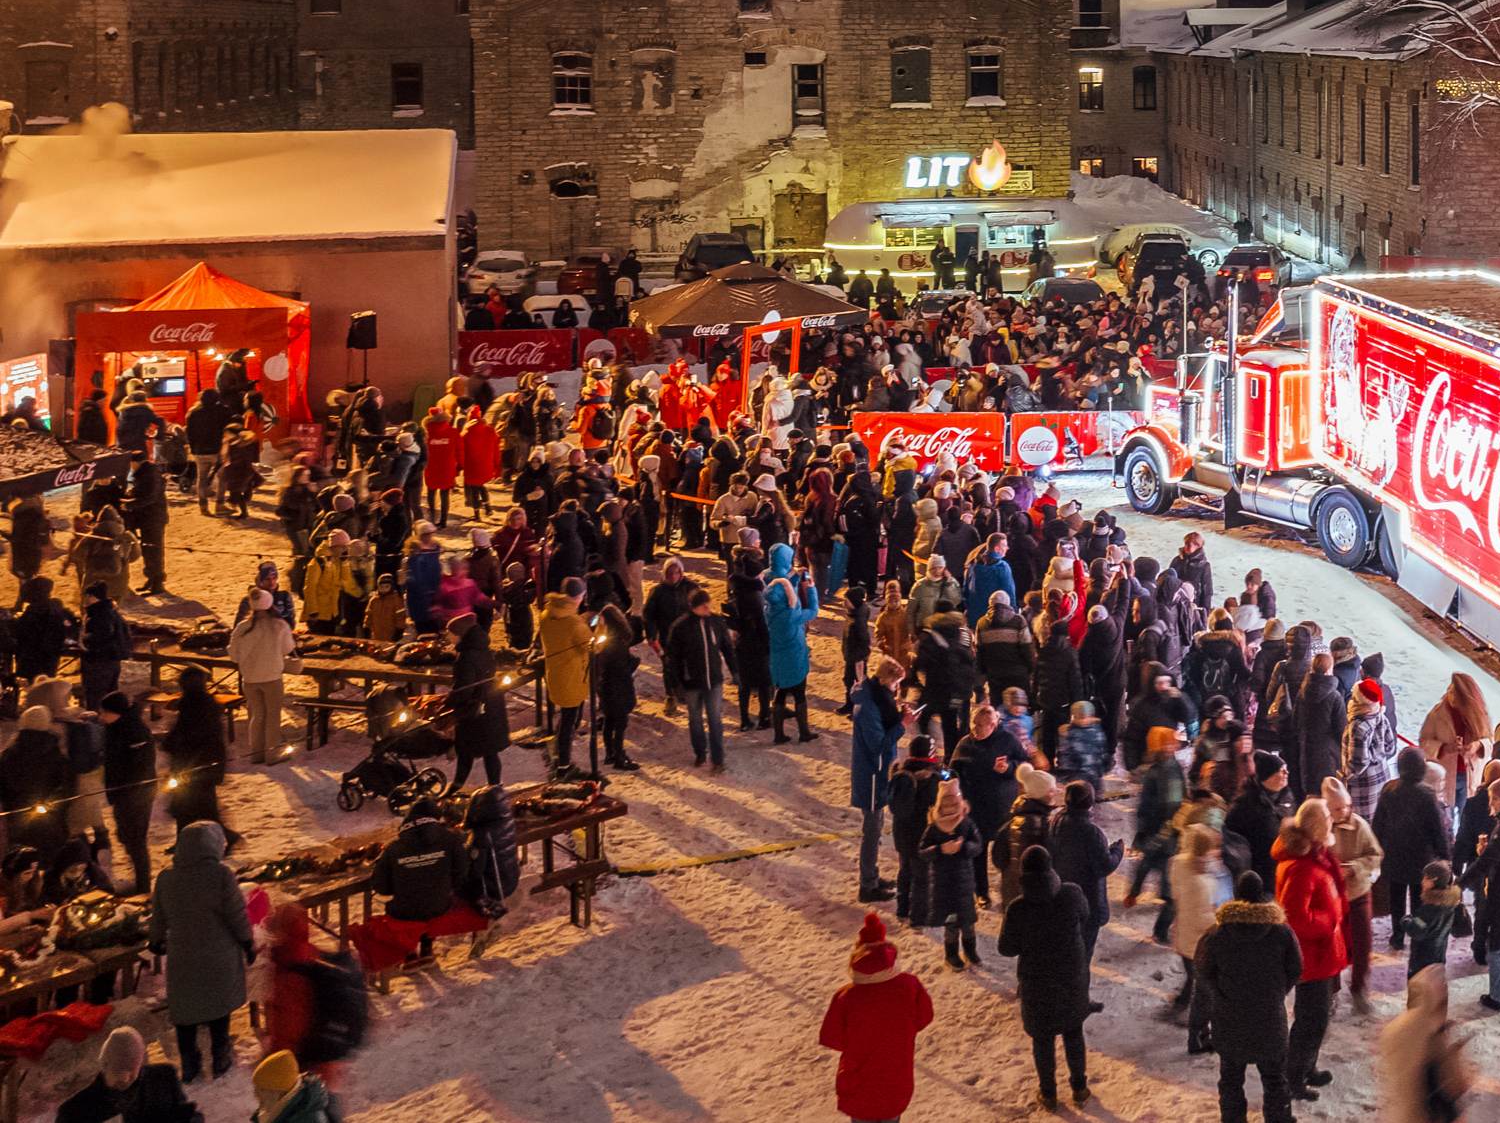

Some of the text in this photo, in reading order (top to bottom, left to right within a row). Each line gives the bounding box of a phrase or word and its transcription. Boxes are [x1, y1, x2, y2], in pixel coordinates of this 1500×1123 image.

[906, 156, 970, 188] LIT
[692, 323, 731, 337] Coca-Cola
[801, 315, 837, 329] Coca-Cola
[150, 322, 217, 344] Coca-Cola
[469, 341, 549, 367] Coca-Cola
[1020, 439, 1055, 452] Coca-Cola
